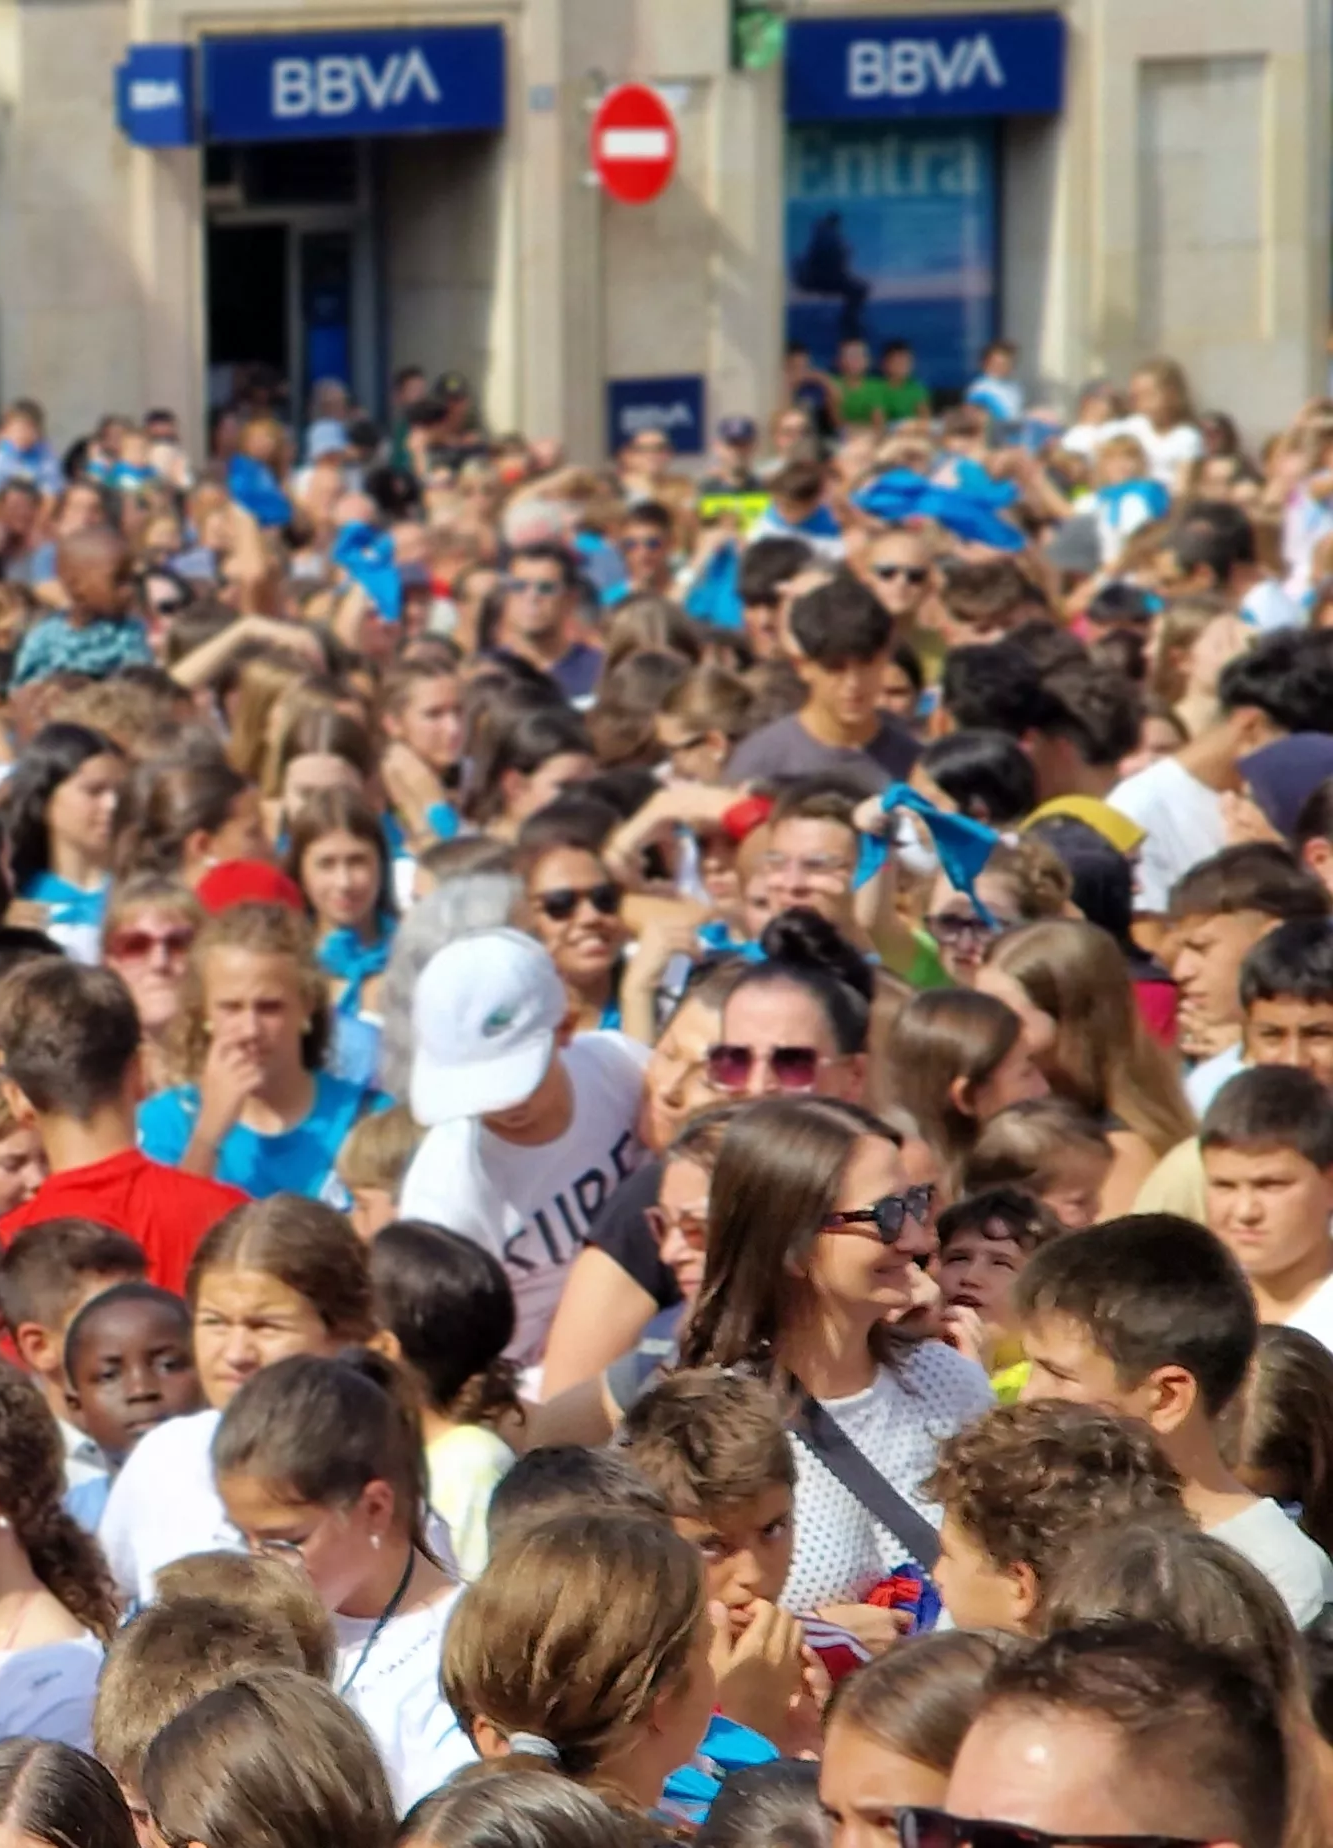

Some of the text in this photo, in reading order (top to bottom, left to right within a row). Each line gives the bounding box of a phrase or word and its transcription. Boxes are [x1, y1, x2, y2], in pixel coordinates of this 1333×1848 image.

[128, 79, 181, 111] BBVA
[272, 48, 440, 118] BBVA
[848, 34, 1004, 97] BBVA
[785, 132, 979, 197] Entra
